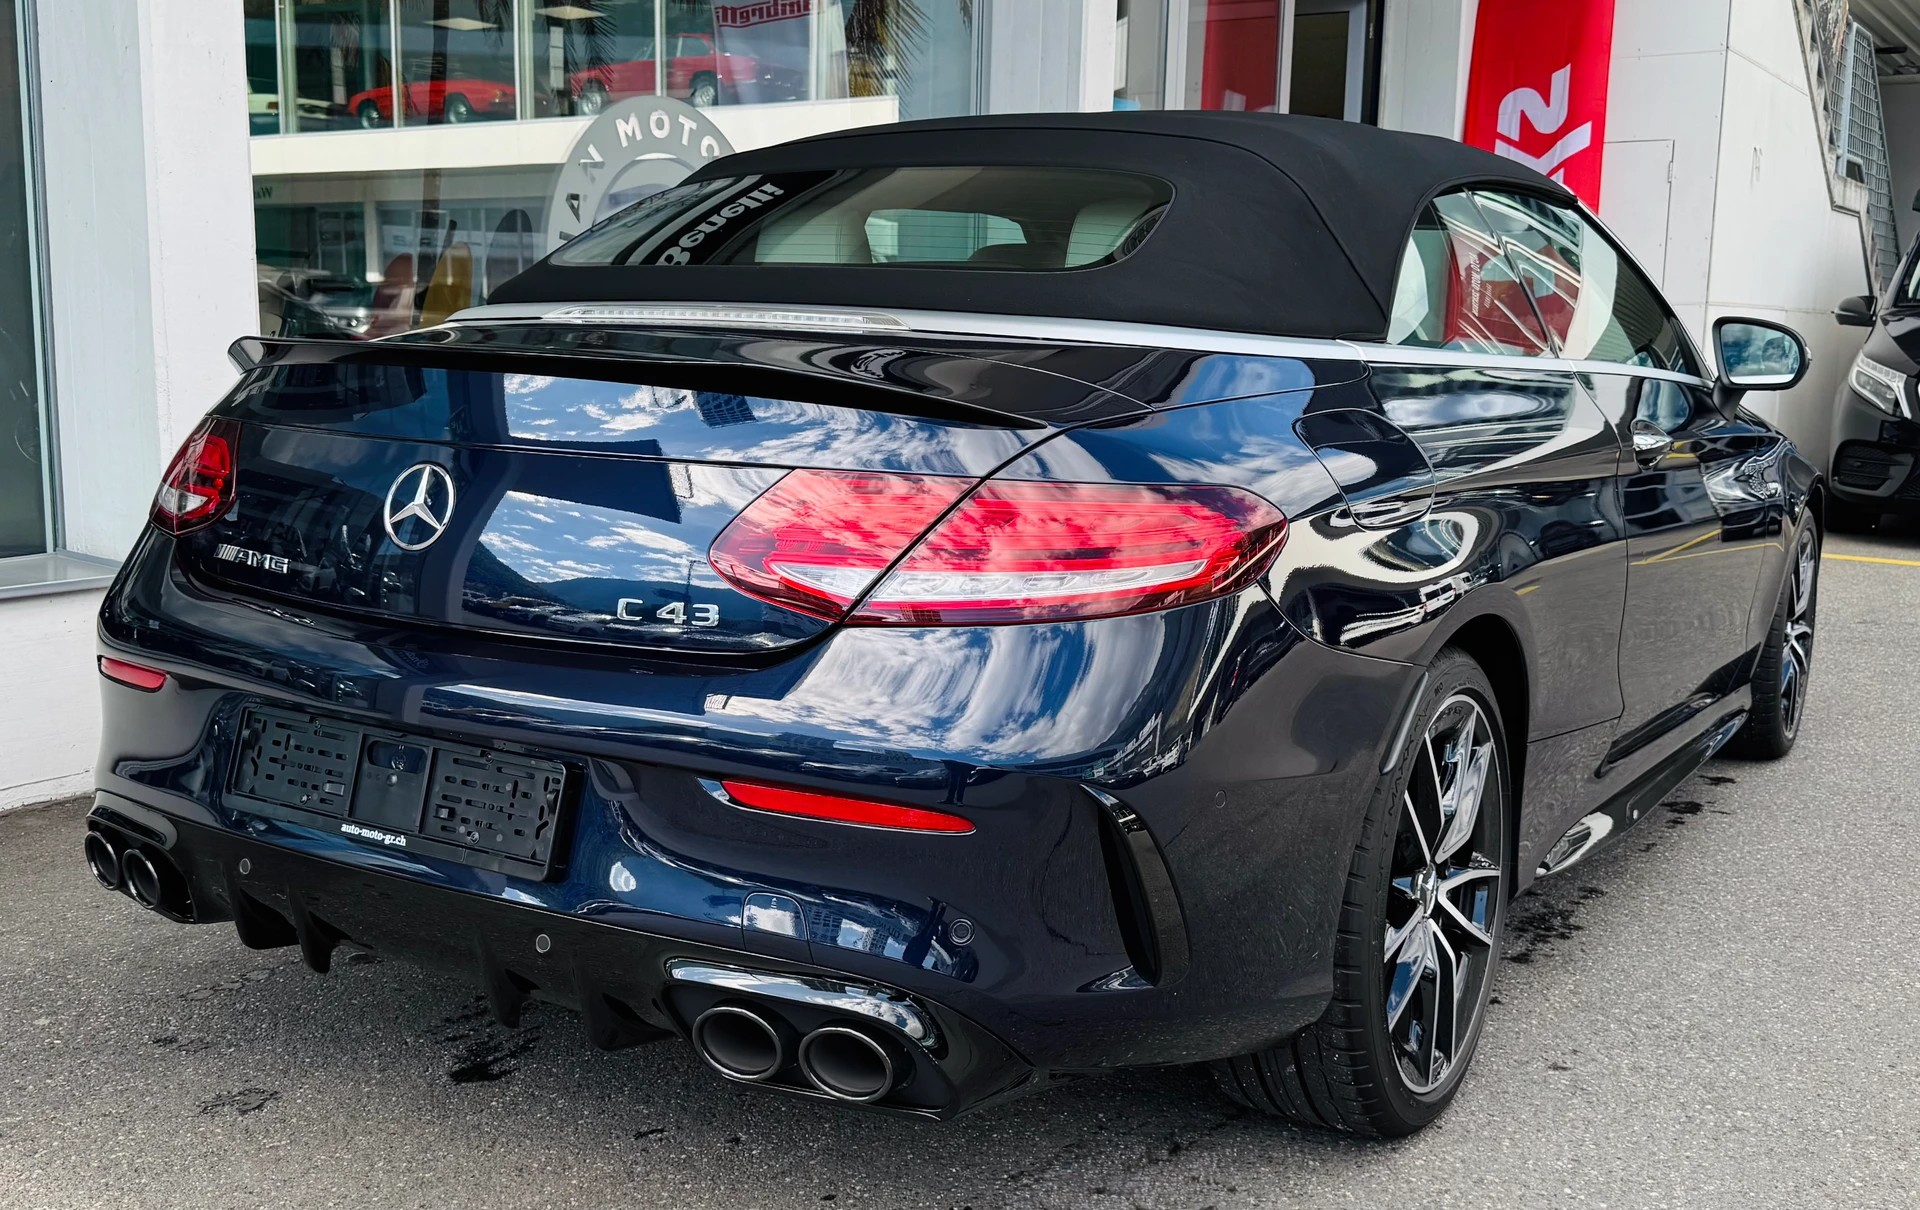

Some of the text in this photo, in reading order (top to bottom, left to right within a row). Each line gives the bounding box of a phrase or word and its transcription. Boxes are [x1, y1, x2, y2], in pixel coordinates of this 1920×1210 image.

[236, 547, 289, 574] AMG
[617, 598, 719, 627] C 43
[341, 823, 406, 847] auto-moto-gr.ch
